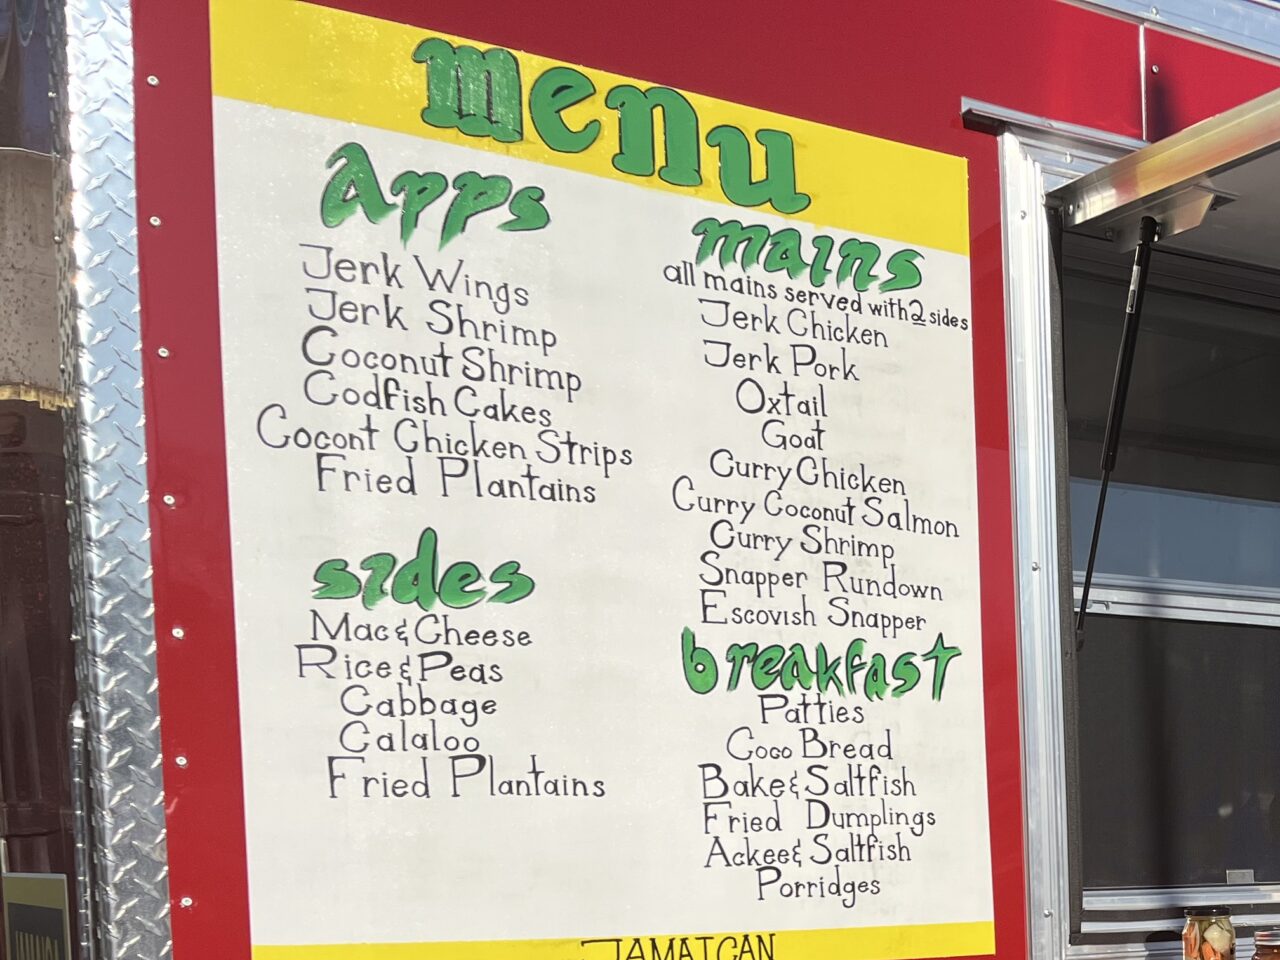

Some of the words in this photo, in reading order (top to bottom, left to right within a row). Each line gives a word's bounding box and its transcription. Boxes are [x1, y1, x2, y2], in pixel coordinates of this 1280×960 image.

[412, 37, 811, 214] menu
[320, 142, 552, 250] Apps
[299, 243, 405, 289] Jerk
[413, 254, 529, 315] Wings
[692, 216, 925, 294] mains
[663, 260, 696, 287] all
[703, 271, 778, 300] mains
[784, 287, 863, 315] served
[867, 299, 908, 322] with
[929, 309, 969, 331] sides
[304, 287, 409, 331] Jerk
[425, 299, 557, 356] Shrimp
[698, 298, 781, 335] Jerk
[787, 307, 889, 348] Chicken
[301, 325, 454, 378] Coconut
[461, 346, 582, 403] Shrimp
[703, 339, 782, 375] Jerk
[790, 343, 861, 381] Pork
[303, 369, 447, 416] Codfish
[454, 385, 552, 427] Cakes
[736, 378, 828, 417] Oxtail
[256, 403, 380, 451] Cocont
[393, 418, 528, 460] Chicken
[536, 429, 633, 478] Strips
[761, 418, 826, 451] Goat
[315, 452, 418, 496] Fried
[436, 455, 597, 503] Plantains
[709, 448, 792, 491] Curry
[796, 456, 906, 496] Chicken
[672, 474, 756, 525] Curry
[764, 490, 856, 526] Coconut
[861, 496, 960, 538] Salmon
[311, 526, 536, 612] sides
[709, 519, 793, 561] Curry
[800, 524, 895, 569] Shrimp
[699, 550, 808, 598] Snapper
[822, 560, 944, 601] Rundown
[699, 588, 817, 626] Escovish
[827, 596, 927, 639] Snapper
[681, 626, 963, 702] breakfast
[340, 682, 498, 728] Cabbage
[760, 695, 865, 726] Patties
[339, 719, 480, 753] Calaloo
[726, 727, 793, 762] Coco
[800, 727, 893, 762] Bread
[328, 756, 430, 800] Fried
[449, 754, 606, 799] Plantains
[703, 799, 783, 834] Fried
[805, 798, 936, 836] Dumplings
[810, 832, 912, 865] Saltfish
[755, 865, 881, 908] Porridges
